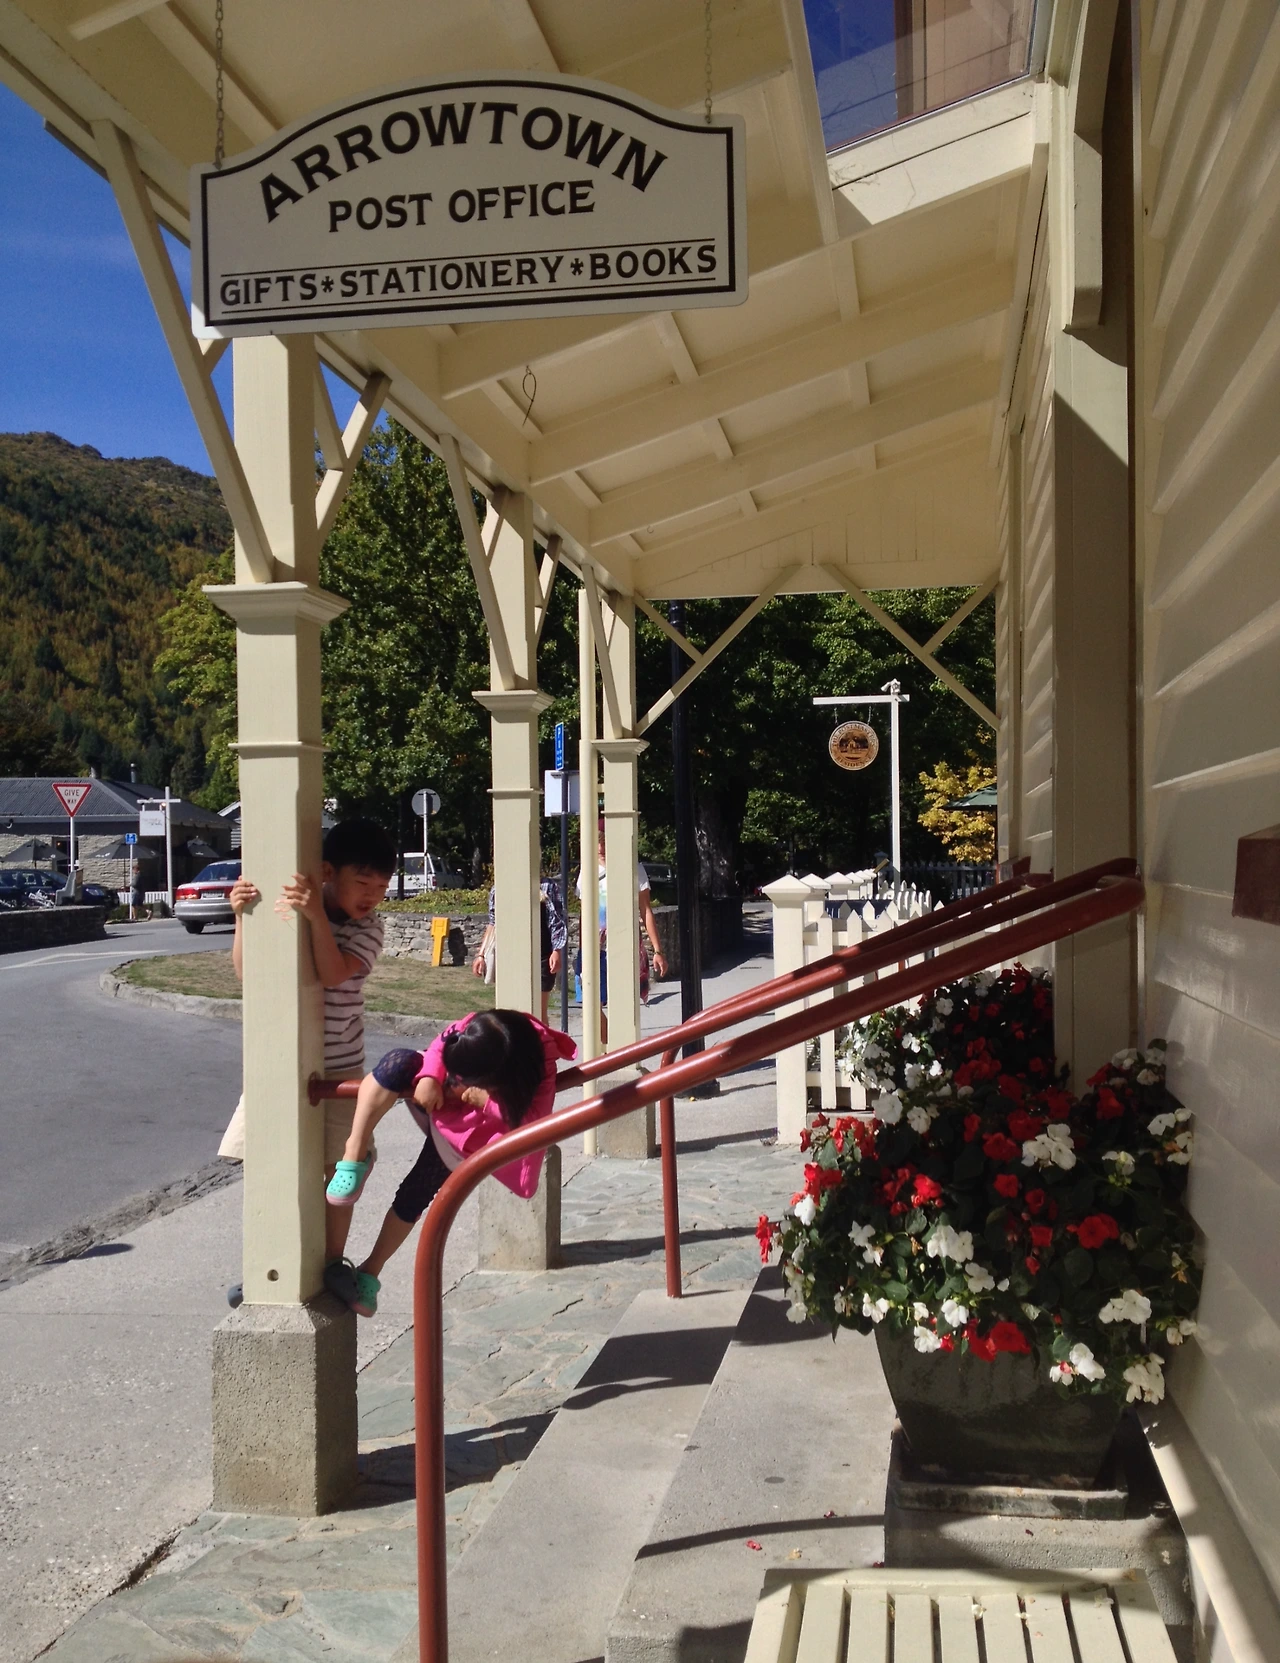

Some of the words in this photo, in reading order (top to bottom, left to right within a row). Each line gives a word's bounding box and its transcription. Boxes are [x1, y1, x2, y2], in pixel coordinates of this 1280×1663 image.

[259, 101, 668, 223] ARROWTOWN
[328, 192, 433, 233] POST
[448, 179, 596, 222] OFFICE
[220, 273, 318, 307] GIFTS
[340, 255, 565, 299] STATIONERY
[588, 244, 718, 281] BOOKS
[64, 789, 80, 797] GIVE
